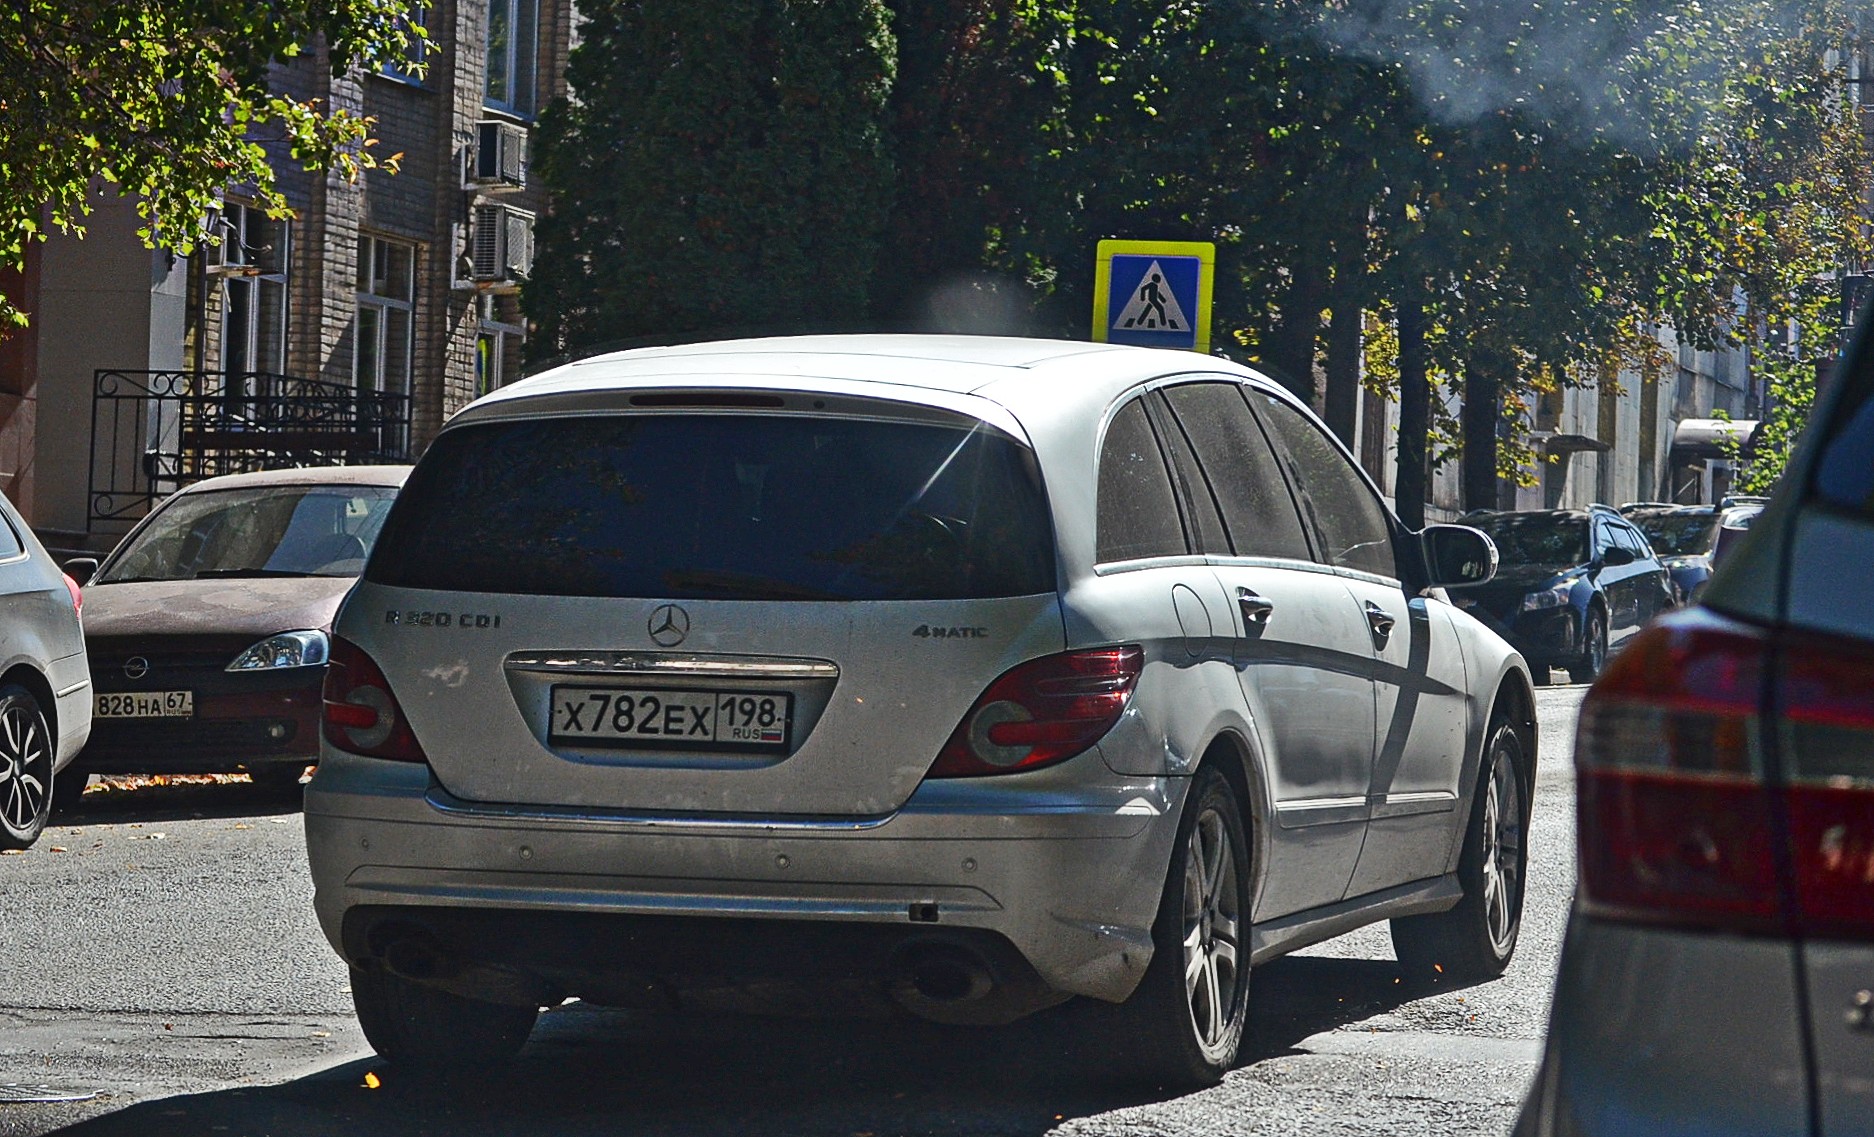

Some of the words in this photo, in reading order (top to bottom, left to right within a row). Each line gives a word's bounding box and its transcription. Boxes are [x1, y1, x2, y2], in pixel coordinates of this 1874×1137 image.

[166, 693, 186, 709] 67
[720, 697, 776, 727] 198
[733, 728, 760, 739] RUS
